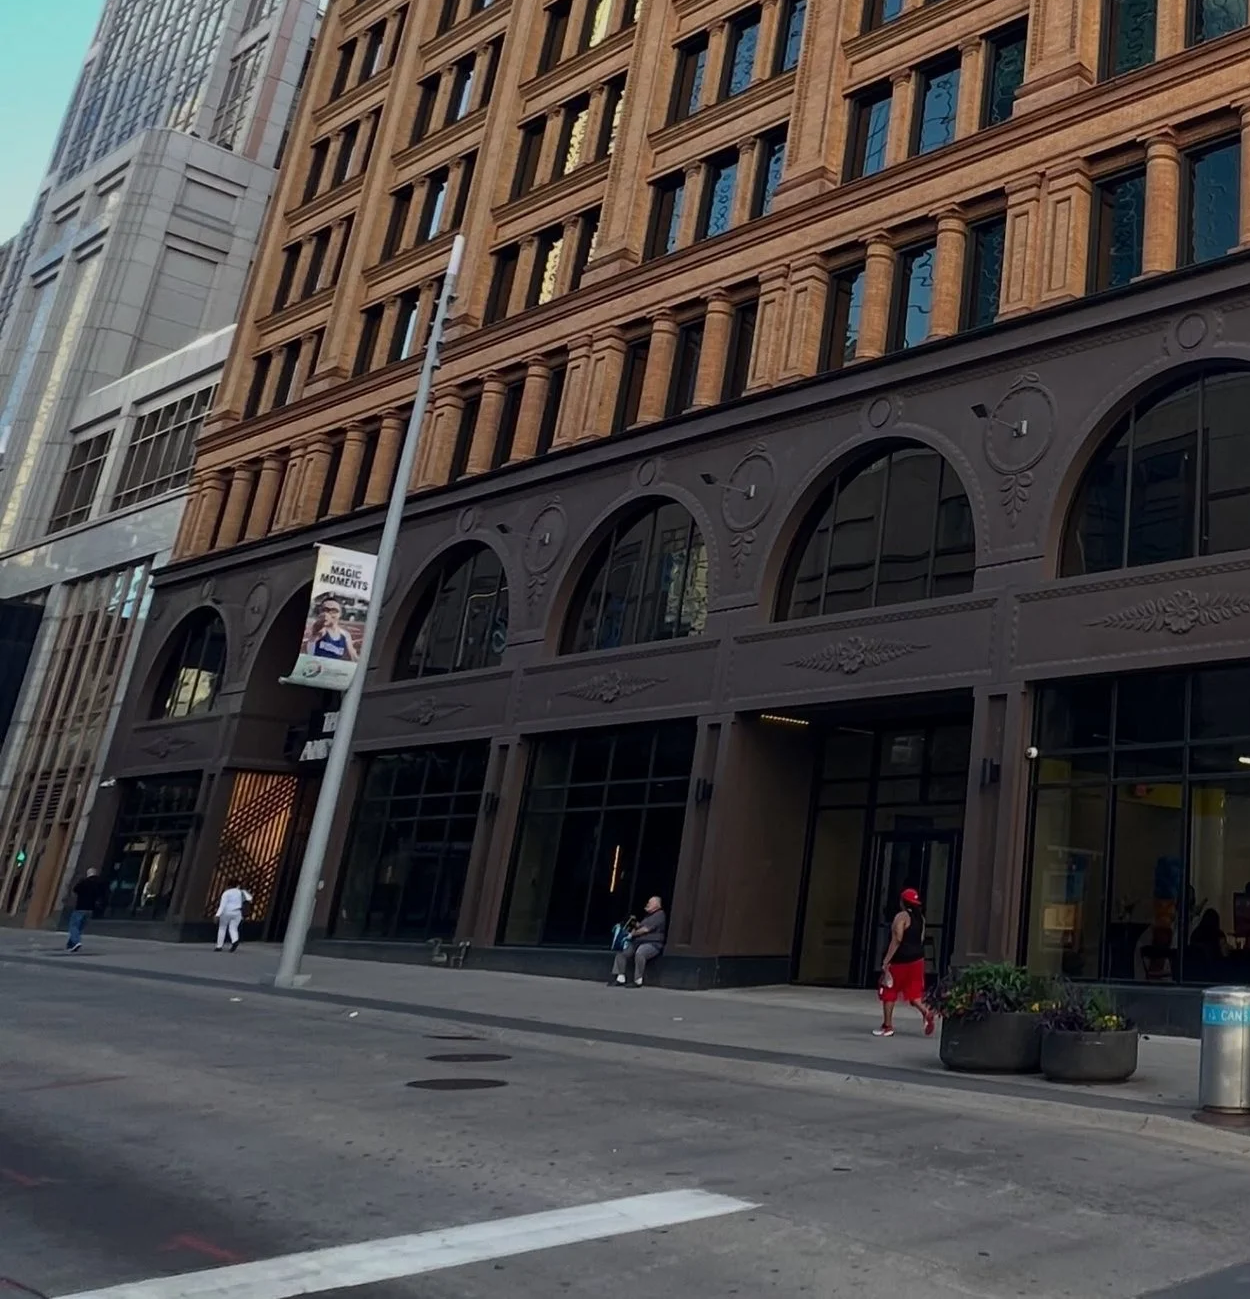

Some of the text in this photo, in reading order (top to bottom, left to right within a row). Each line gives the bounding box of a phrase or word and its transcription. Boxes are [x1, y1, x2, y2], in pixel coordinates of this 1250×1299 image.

[330, 565, 362, 579] MAGIC
[320, 573, 369, 591] MOMENTS
[1220, 1009, 1248, 1022] CANS
